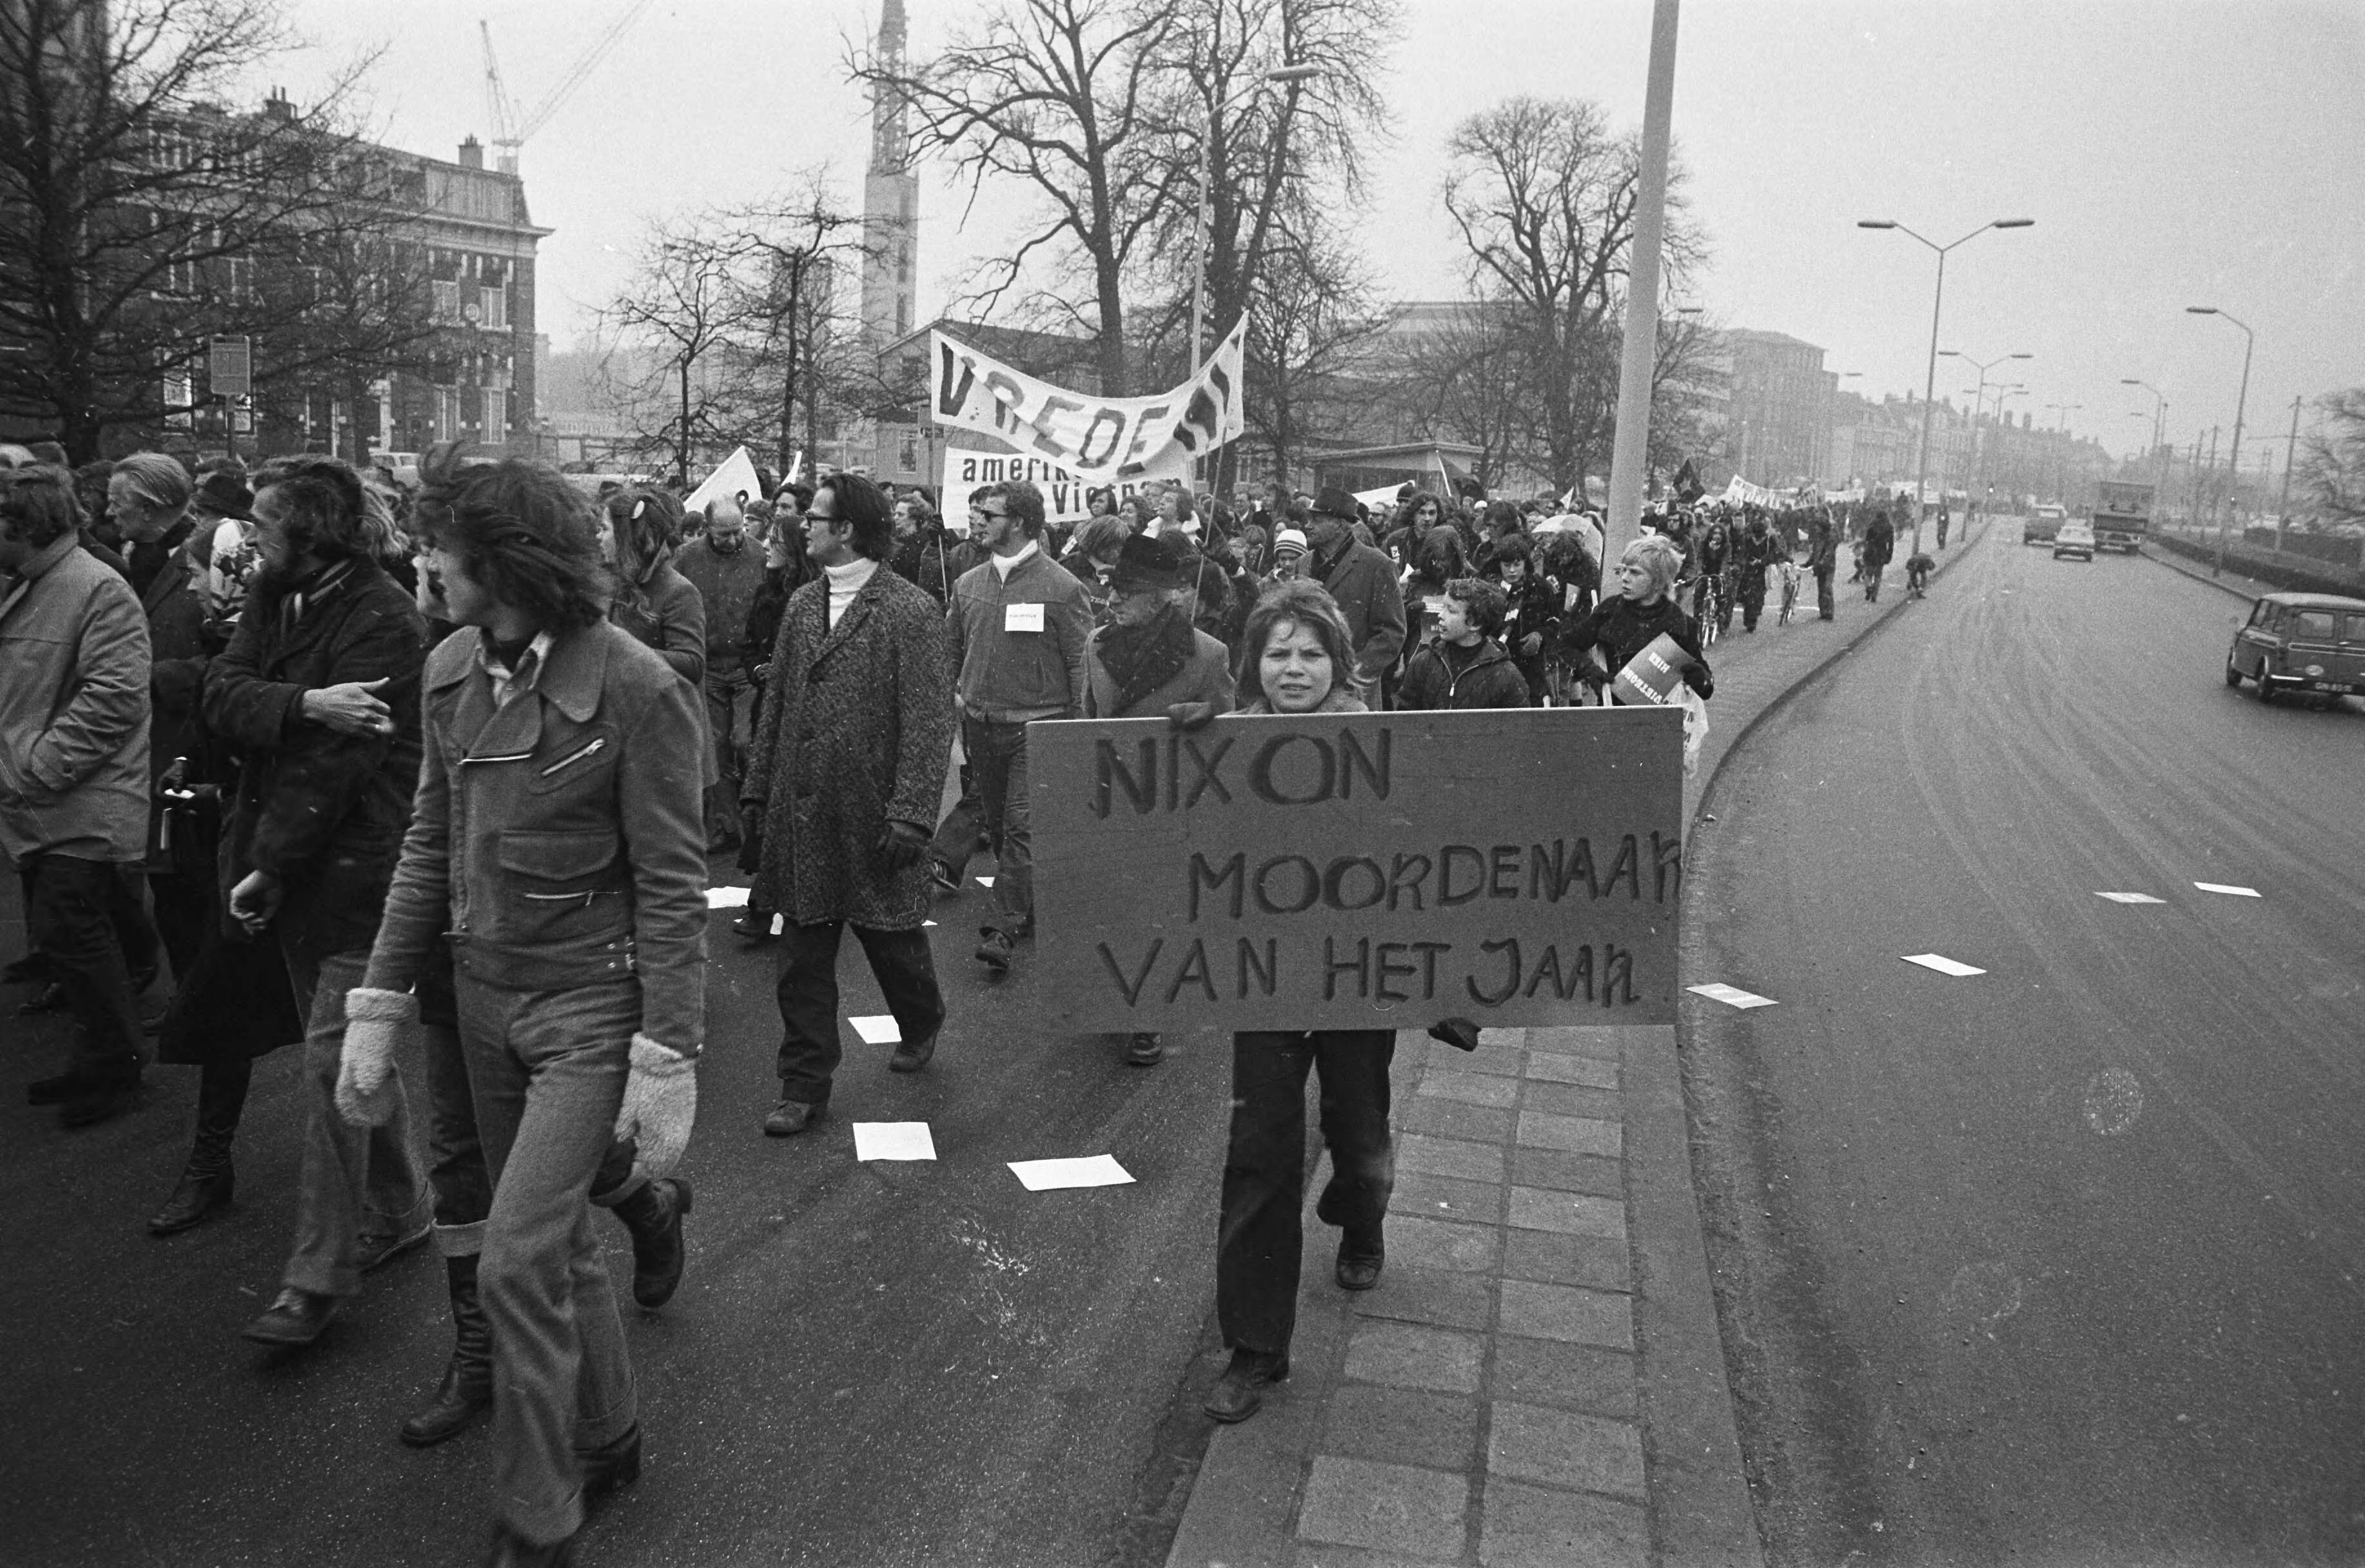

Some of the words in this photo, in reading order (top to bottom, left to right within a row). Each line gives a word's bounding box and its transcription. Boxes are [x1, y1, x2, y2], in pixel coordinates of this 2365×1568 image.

[939, 342, 1171, 476] VREDE
[1090, 727, 1391, 818] NIXON
[1188, 830, 1682, 922] MOORDENAAR
[1097, 937, 1278, 1006] VAN
[1322, 936, 1450, 1003] HET
[1466, 937, 1641, 1007] JAAR
